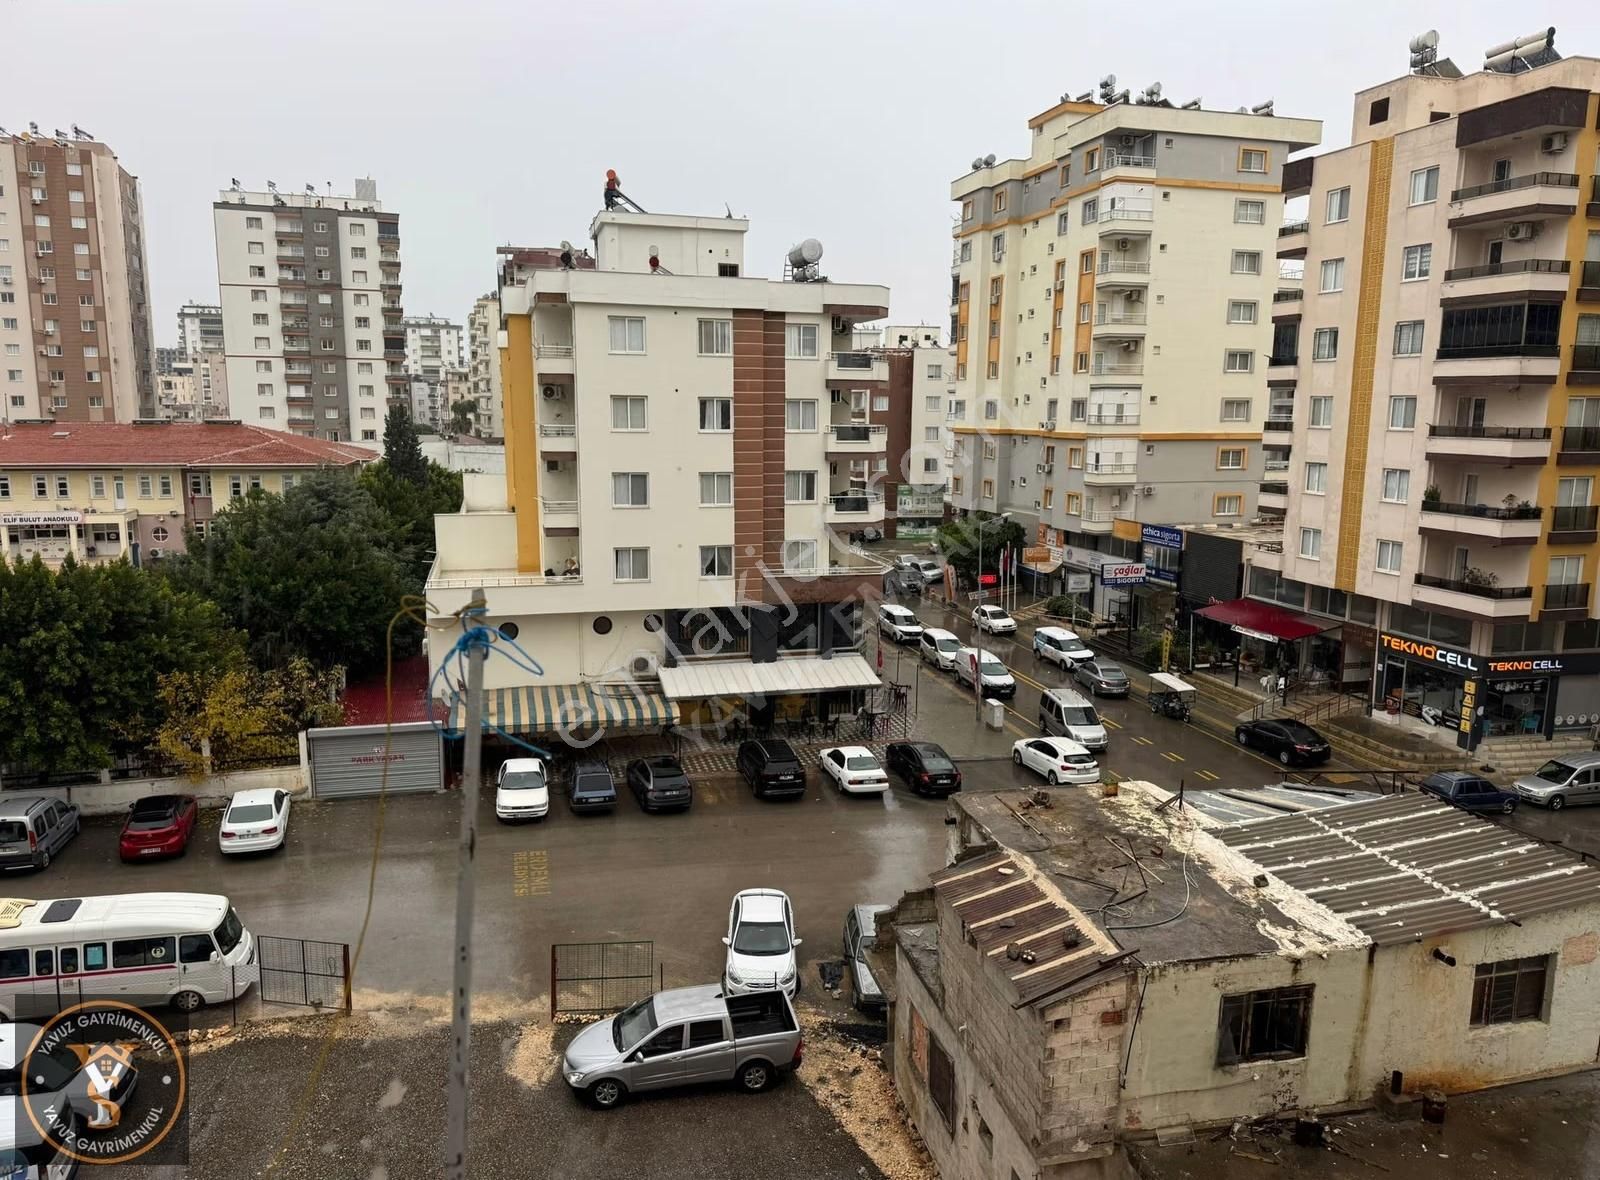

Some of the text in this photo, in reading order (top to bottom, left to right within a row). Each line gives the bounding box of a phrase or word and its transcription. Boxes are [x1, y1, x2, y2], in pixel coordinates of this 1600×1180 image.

[1142, 526, 1180, 541] ethica sigorta
[1113, 564, 1144, 577] çağlar
[1381, 634, 1479, 672] TEKNOCELL
[1488, 659, 1563, 671] TEKNOCELL
